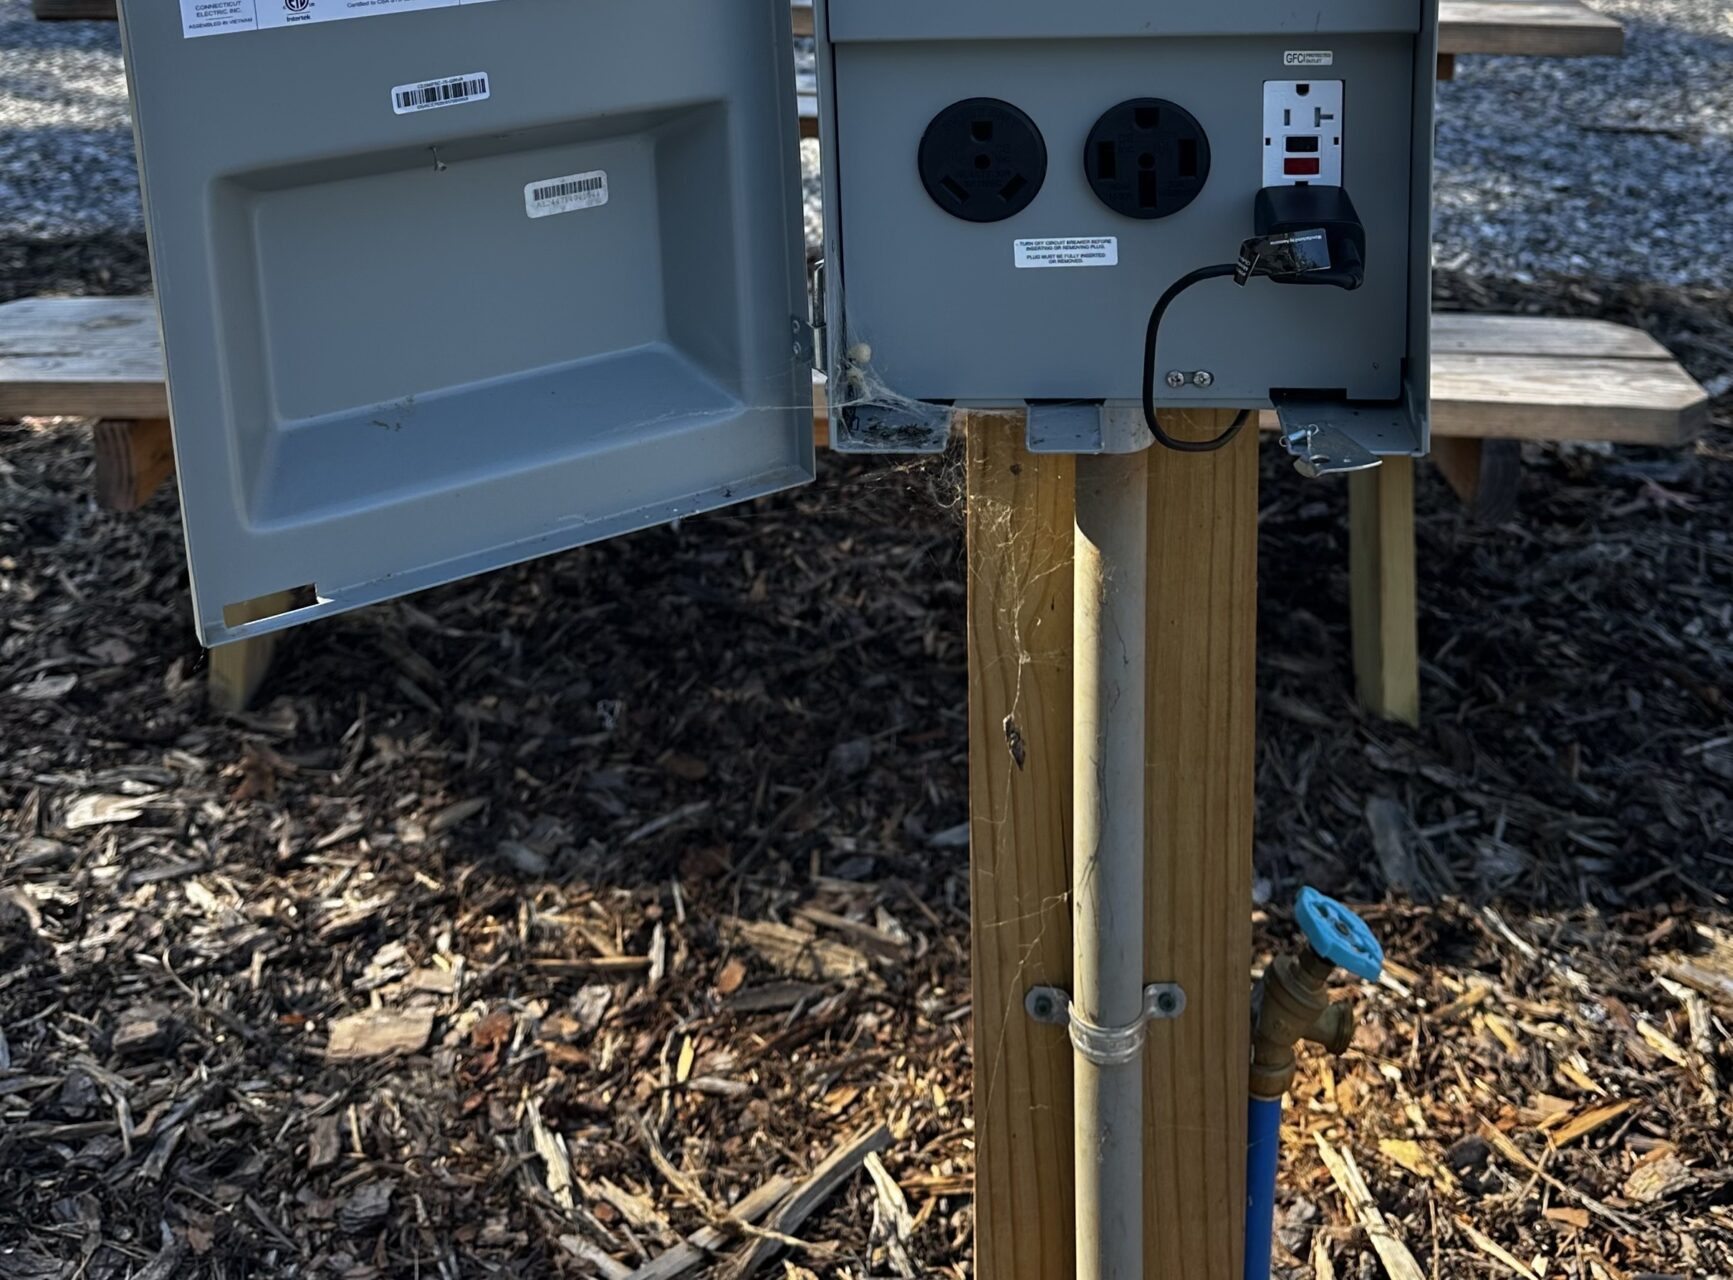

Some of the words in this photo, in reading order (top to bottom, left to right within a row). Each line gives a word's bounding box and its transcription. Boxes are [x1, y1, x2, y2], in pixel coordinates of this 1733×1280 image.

[195, 0, 242, 11] CONNECTICUT
[196, 8, 228, 17] ELECTRIC
[1286, 53, 1305, 64] GFCI
